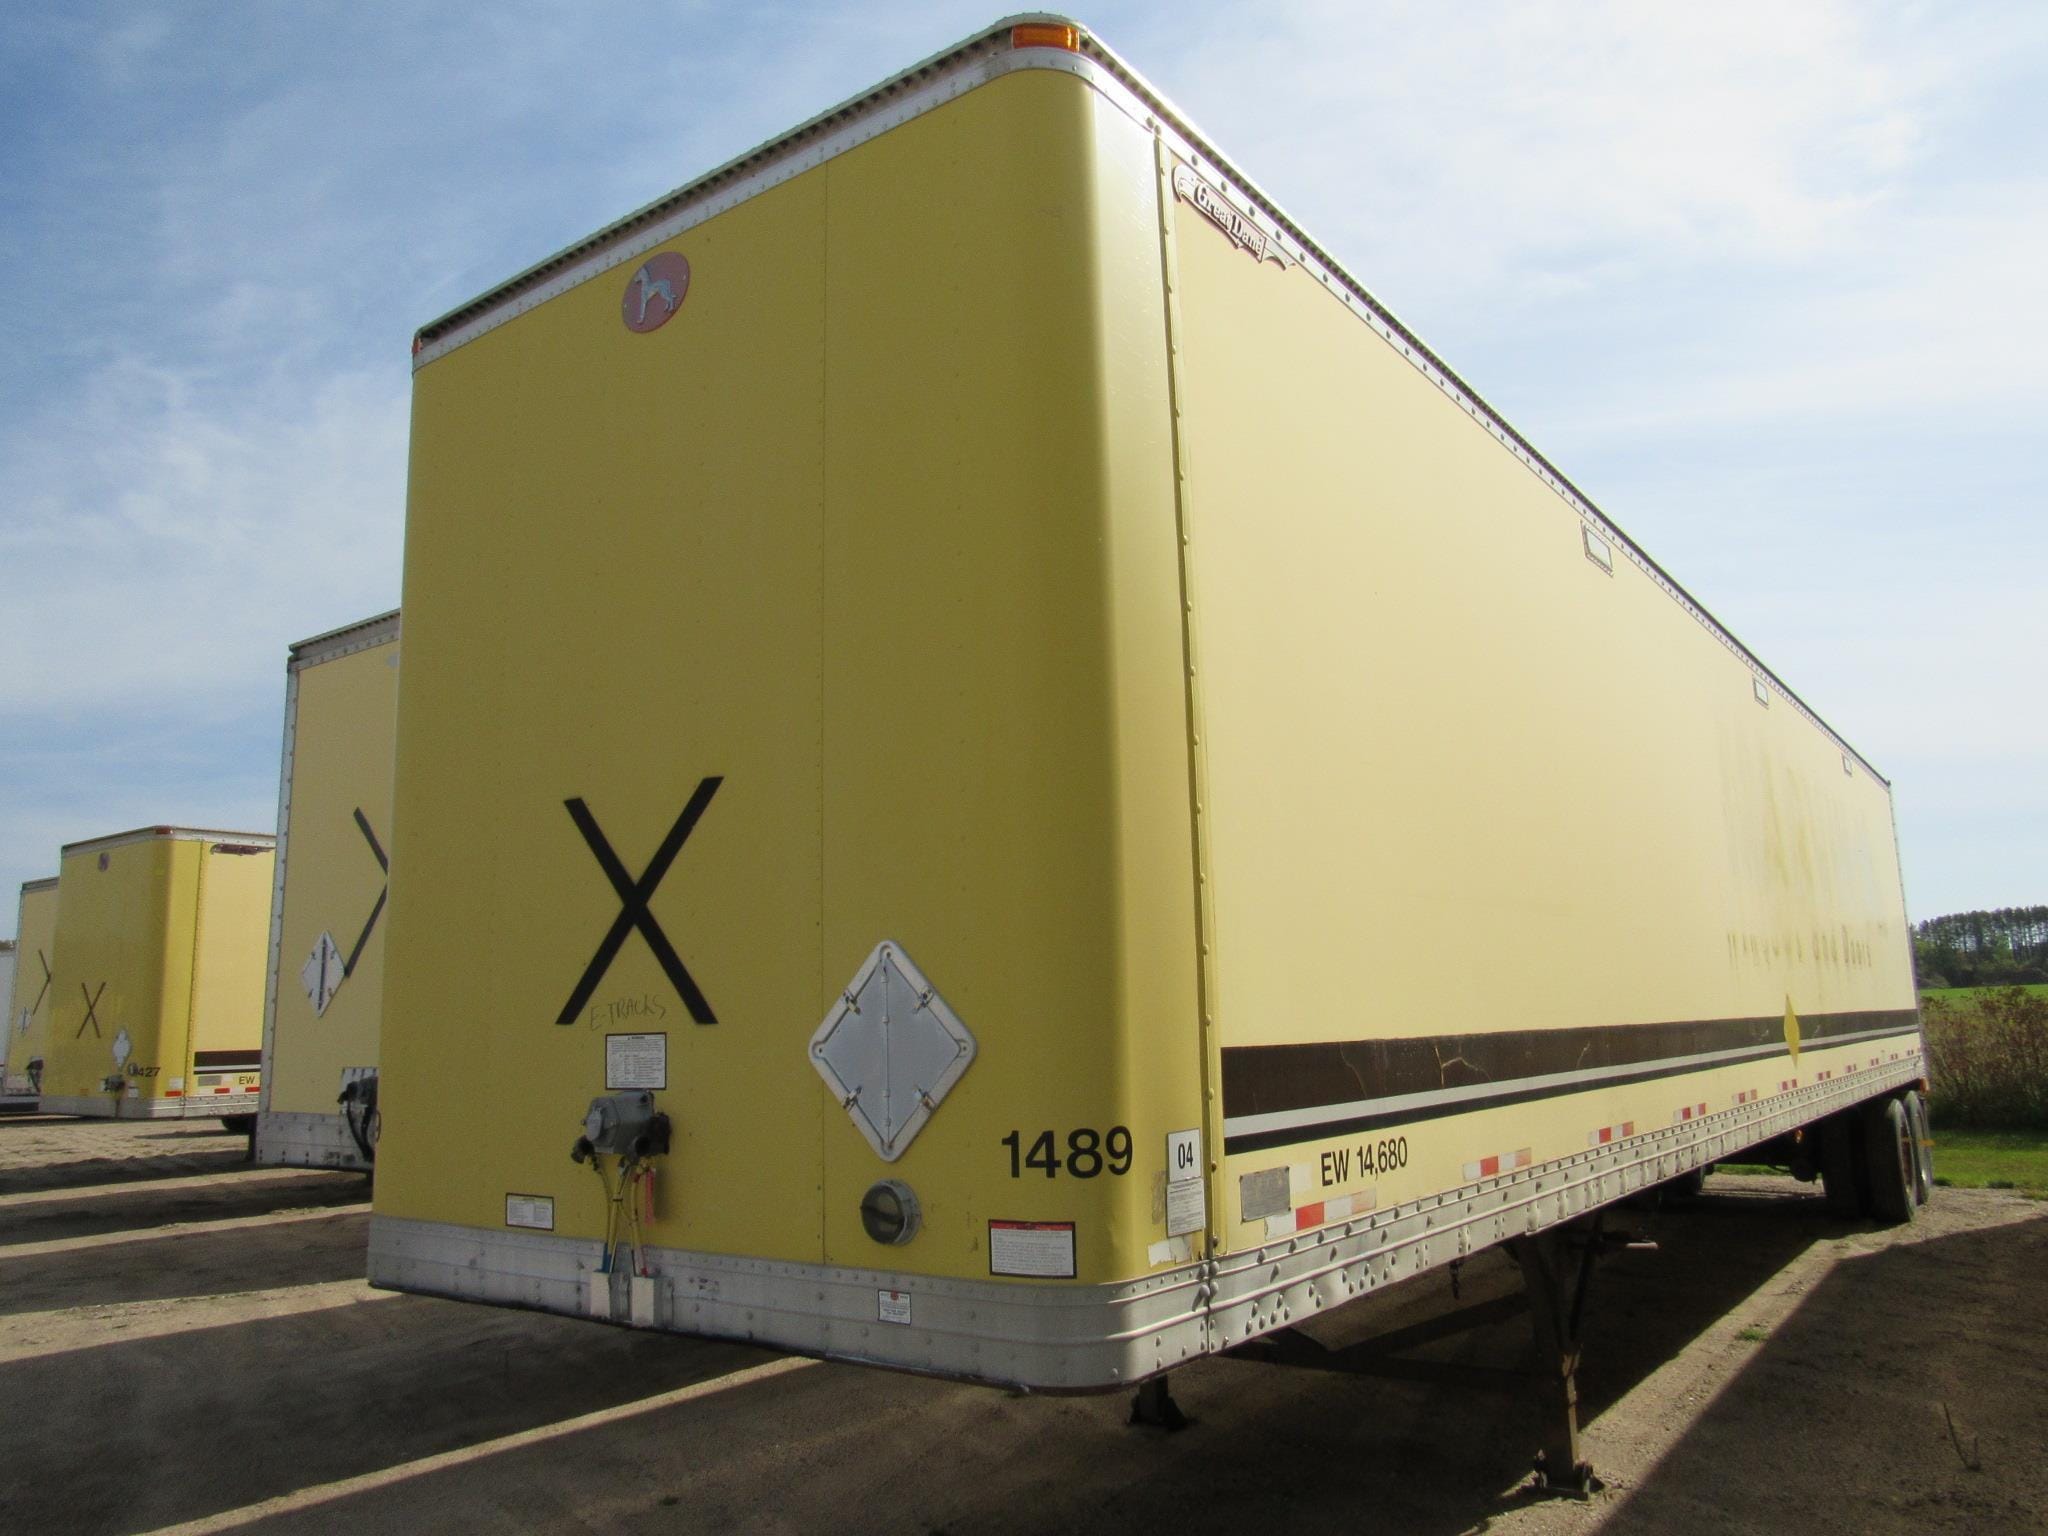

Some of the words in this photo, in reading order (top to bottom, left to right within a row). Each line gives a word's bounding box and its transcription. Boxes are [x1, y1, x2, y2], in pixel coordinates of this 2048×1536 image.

[1194, 183, 1233, 230] Great
[239, 1075, 256, 1085] EW
[1001, 1125, 1133, 1179] 1489
[1178, 1141, 1194, 1170] 04
[1320, 1148, 1350, 1187] EW
[1356, 1136, 1408, 1181] 14,680
